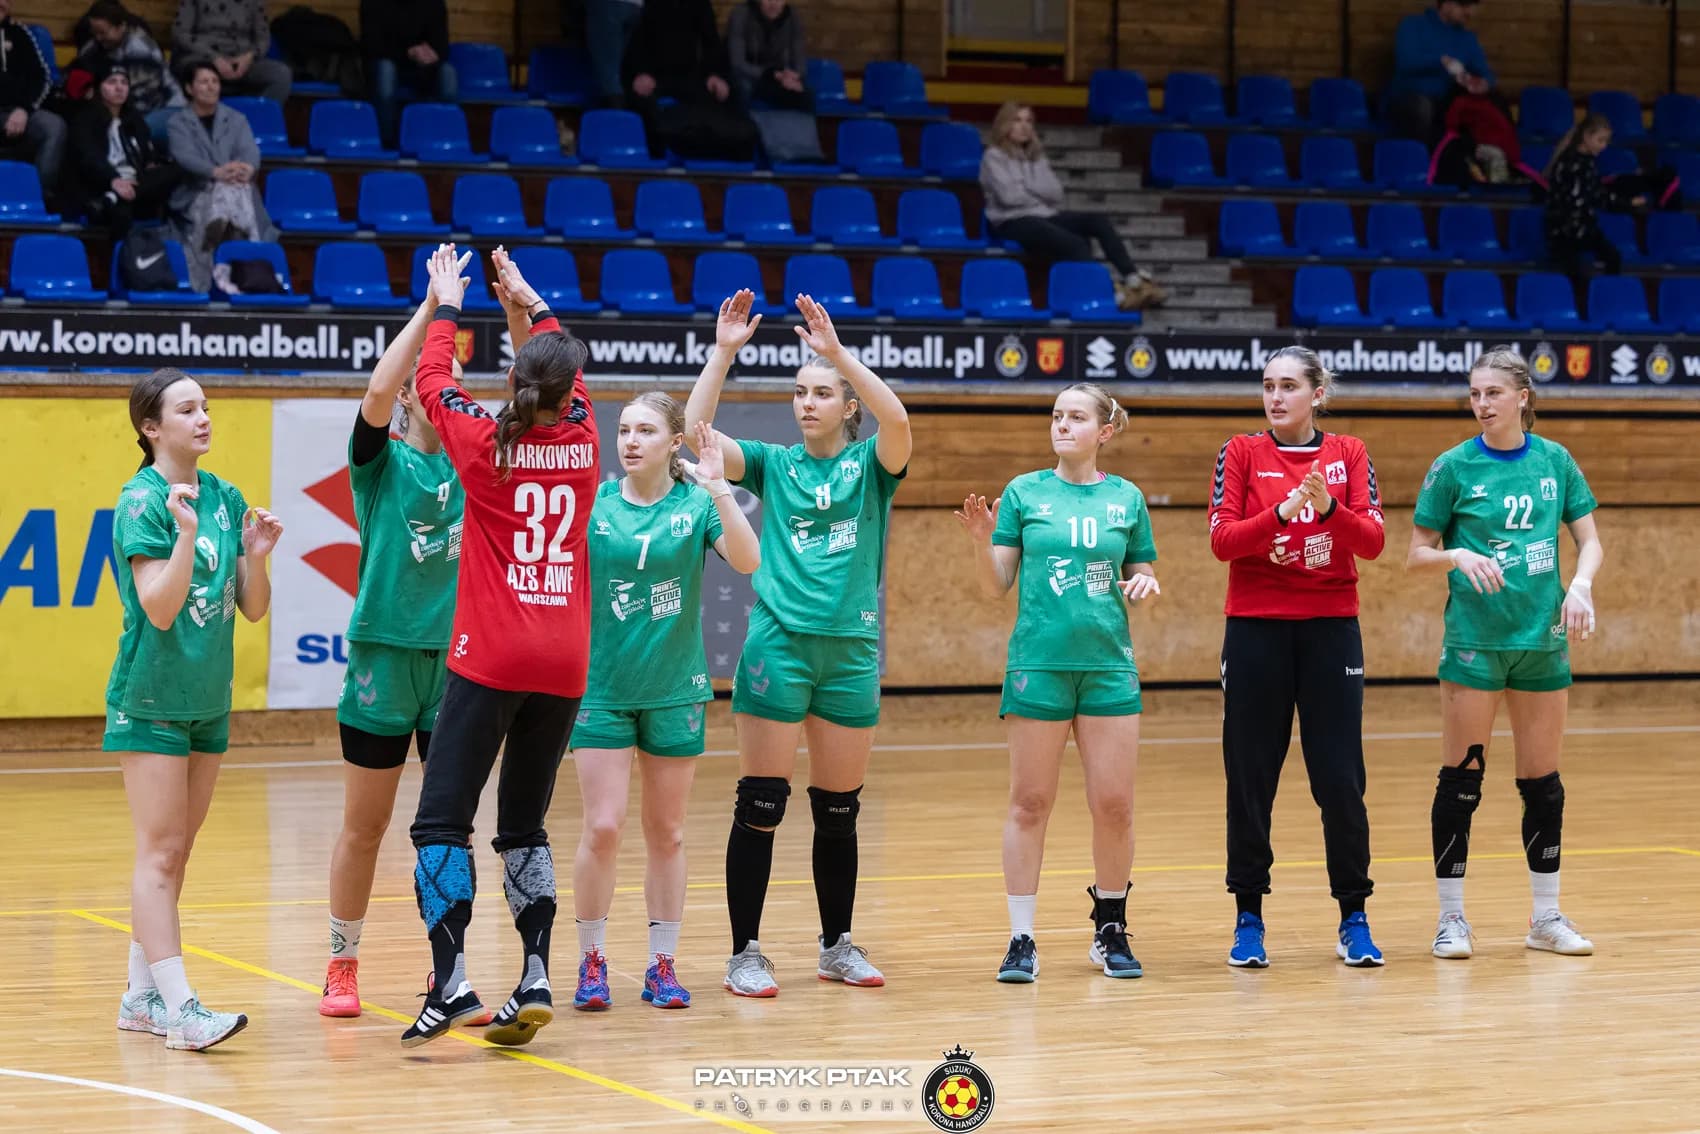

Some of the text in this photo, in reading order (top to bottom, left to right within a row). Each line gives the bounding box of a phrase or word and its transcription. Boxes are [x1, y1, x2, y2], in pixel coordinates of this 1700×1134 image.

[1503, 494, 1534, 530] 22
[513, 482, 576, 563] 32
[1067, 516, 1098, 549] 10
[634, 534, 651, 570] 7
[1305, 542, 1331, 556] ACTIVE
[1527, 549, 1553, 561] ACTIVE
[1528, 558, 1553, 571] WEAR
[506, 564, 574, 593] AZS AWF
[1086, 571, 1111, 581] ACTIVE
[651, 581, 674, 595] PRINT
[1087, 580, 1110, 592] WEAR
[518, 592, 568, 606] WARSZAWA
[652, 588, 680, 604] ACTIVE
[652, 599, 681, 616] WEAR
